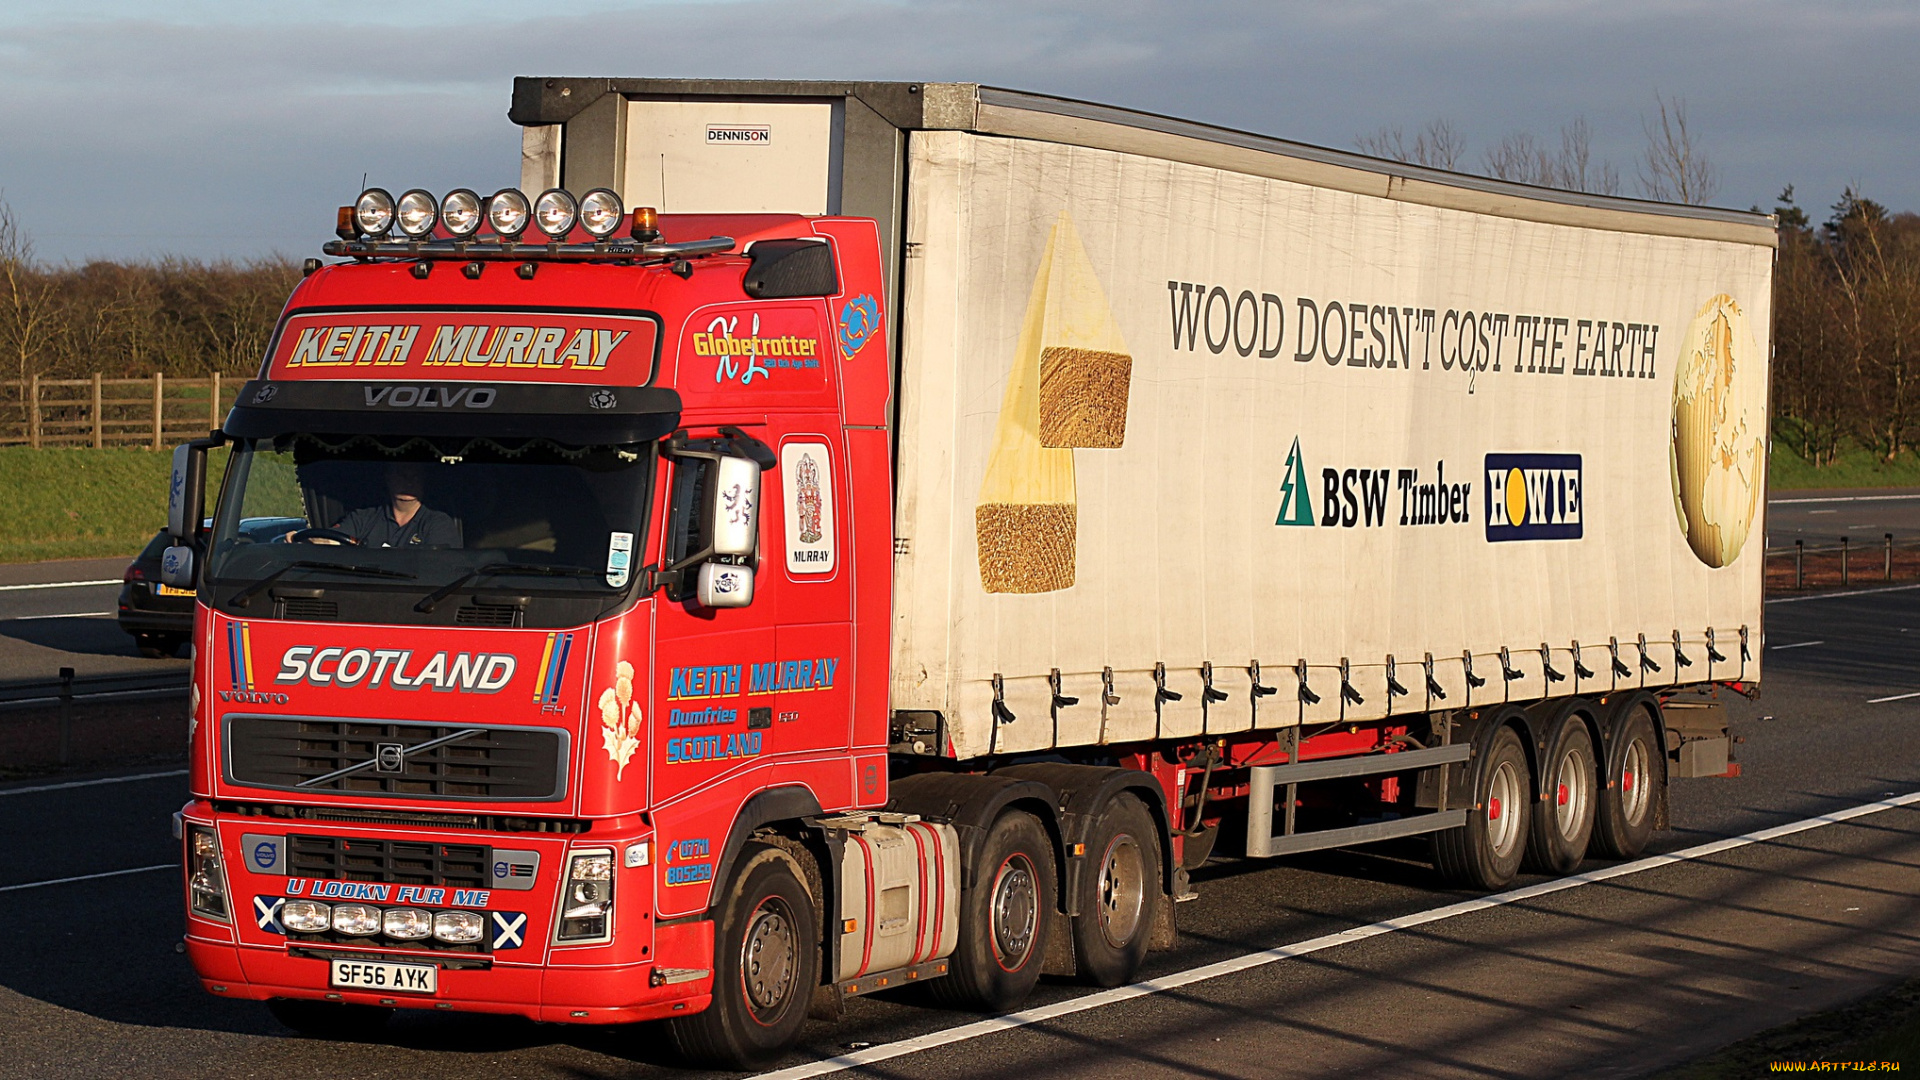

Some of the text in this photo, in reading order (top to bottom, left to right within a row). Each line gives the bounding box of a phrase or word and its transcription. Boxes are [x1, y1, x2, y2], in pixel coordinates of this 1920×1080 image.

[708, 131, 768, 141] DENNISON
[1167, 280, 1285, 358] WOOD
[1294, 298, 1435, 370] DOESN'T
[1513, 315, 1569, 375] THE
[1572, 320, 1659, 379] EARTH
[286, 325, 631, 371] KEITH MURRAY
[692, 332, 817, 356] Globetrotter
[364, 386, 497, 409] VOLVO
[1321, 460, 1471, 527] BSW Timber
[1487, 466, 1580, 527] HOWIE
[793, 551, 829, 562] MURRAY
[274, 646, 518, 693] SCOTLAND
[667, 657, 840, 701] KEITH MURRAY
[218, 690, 289, 705] VOLVO
[541, 705, 567, 716] FH
[668, 707, 738, 728] Dumfries
[666, 732, 762, 764] SCOTLAND
[286, 879, 490, 908] U LOOKN FUR ME
[338, 964, 428, 989] SF56 AYK
